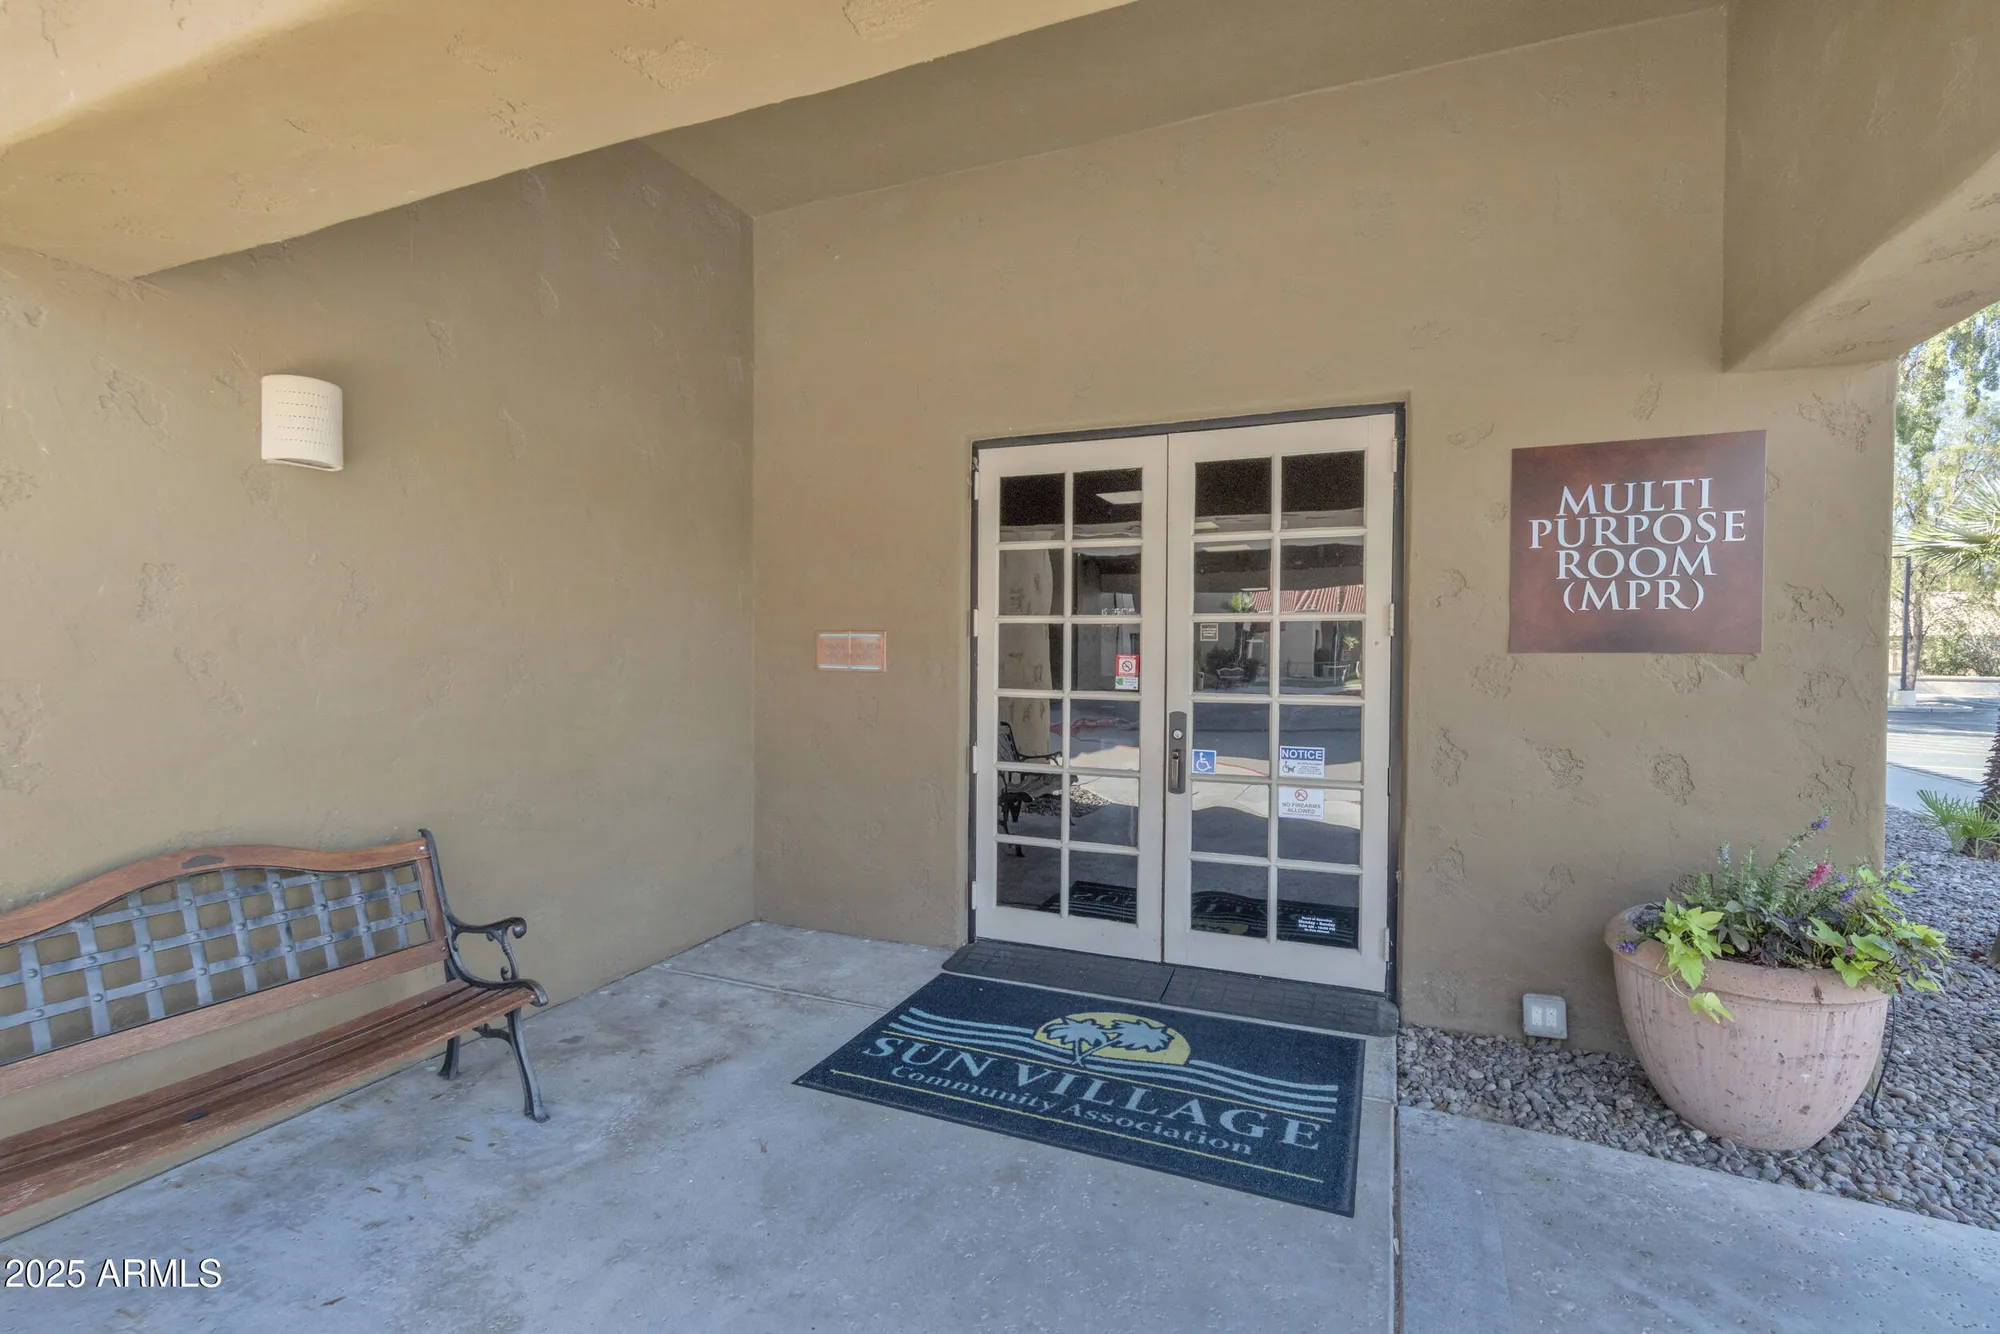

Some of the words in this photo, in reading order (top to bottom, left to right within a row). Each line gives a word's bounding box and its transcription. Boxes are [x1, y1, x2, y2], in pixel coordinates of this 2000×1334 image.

[1556, 477, 1713, 517] MULTI
[1528, 509, 1746, 549] PURPOSE
[1555, 544, 1717, 580] ROOM
[1563, 578, 1704, 614] (MPR)
[1281, 749, 1323, 760] NOTICE
[862, 1037, 998, 1077] SUN
[1015, 1062, 1321, 1150] VILLAGE
[891, 1065, 1057, 1113] Community
[1061, 1102, 1252, 1155] Association
